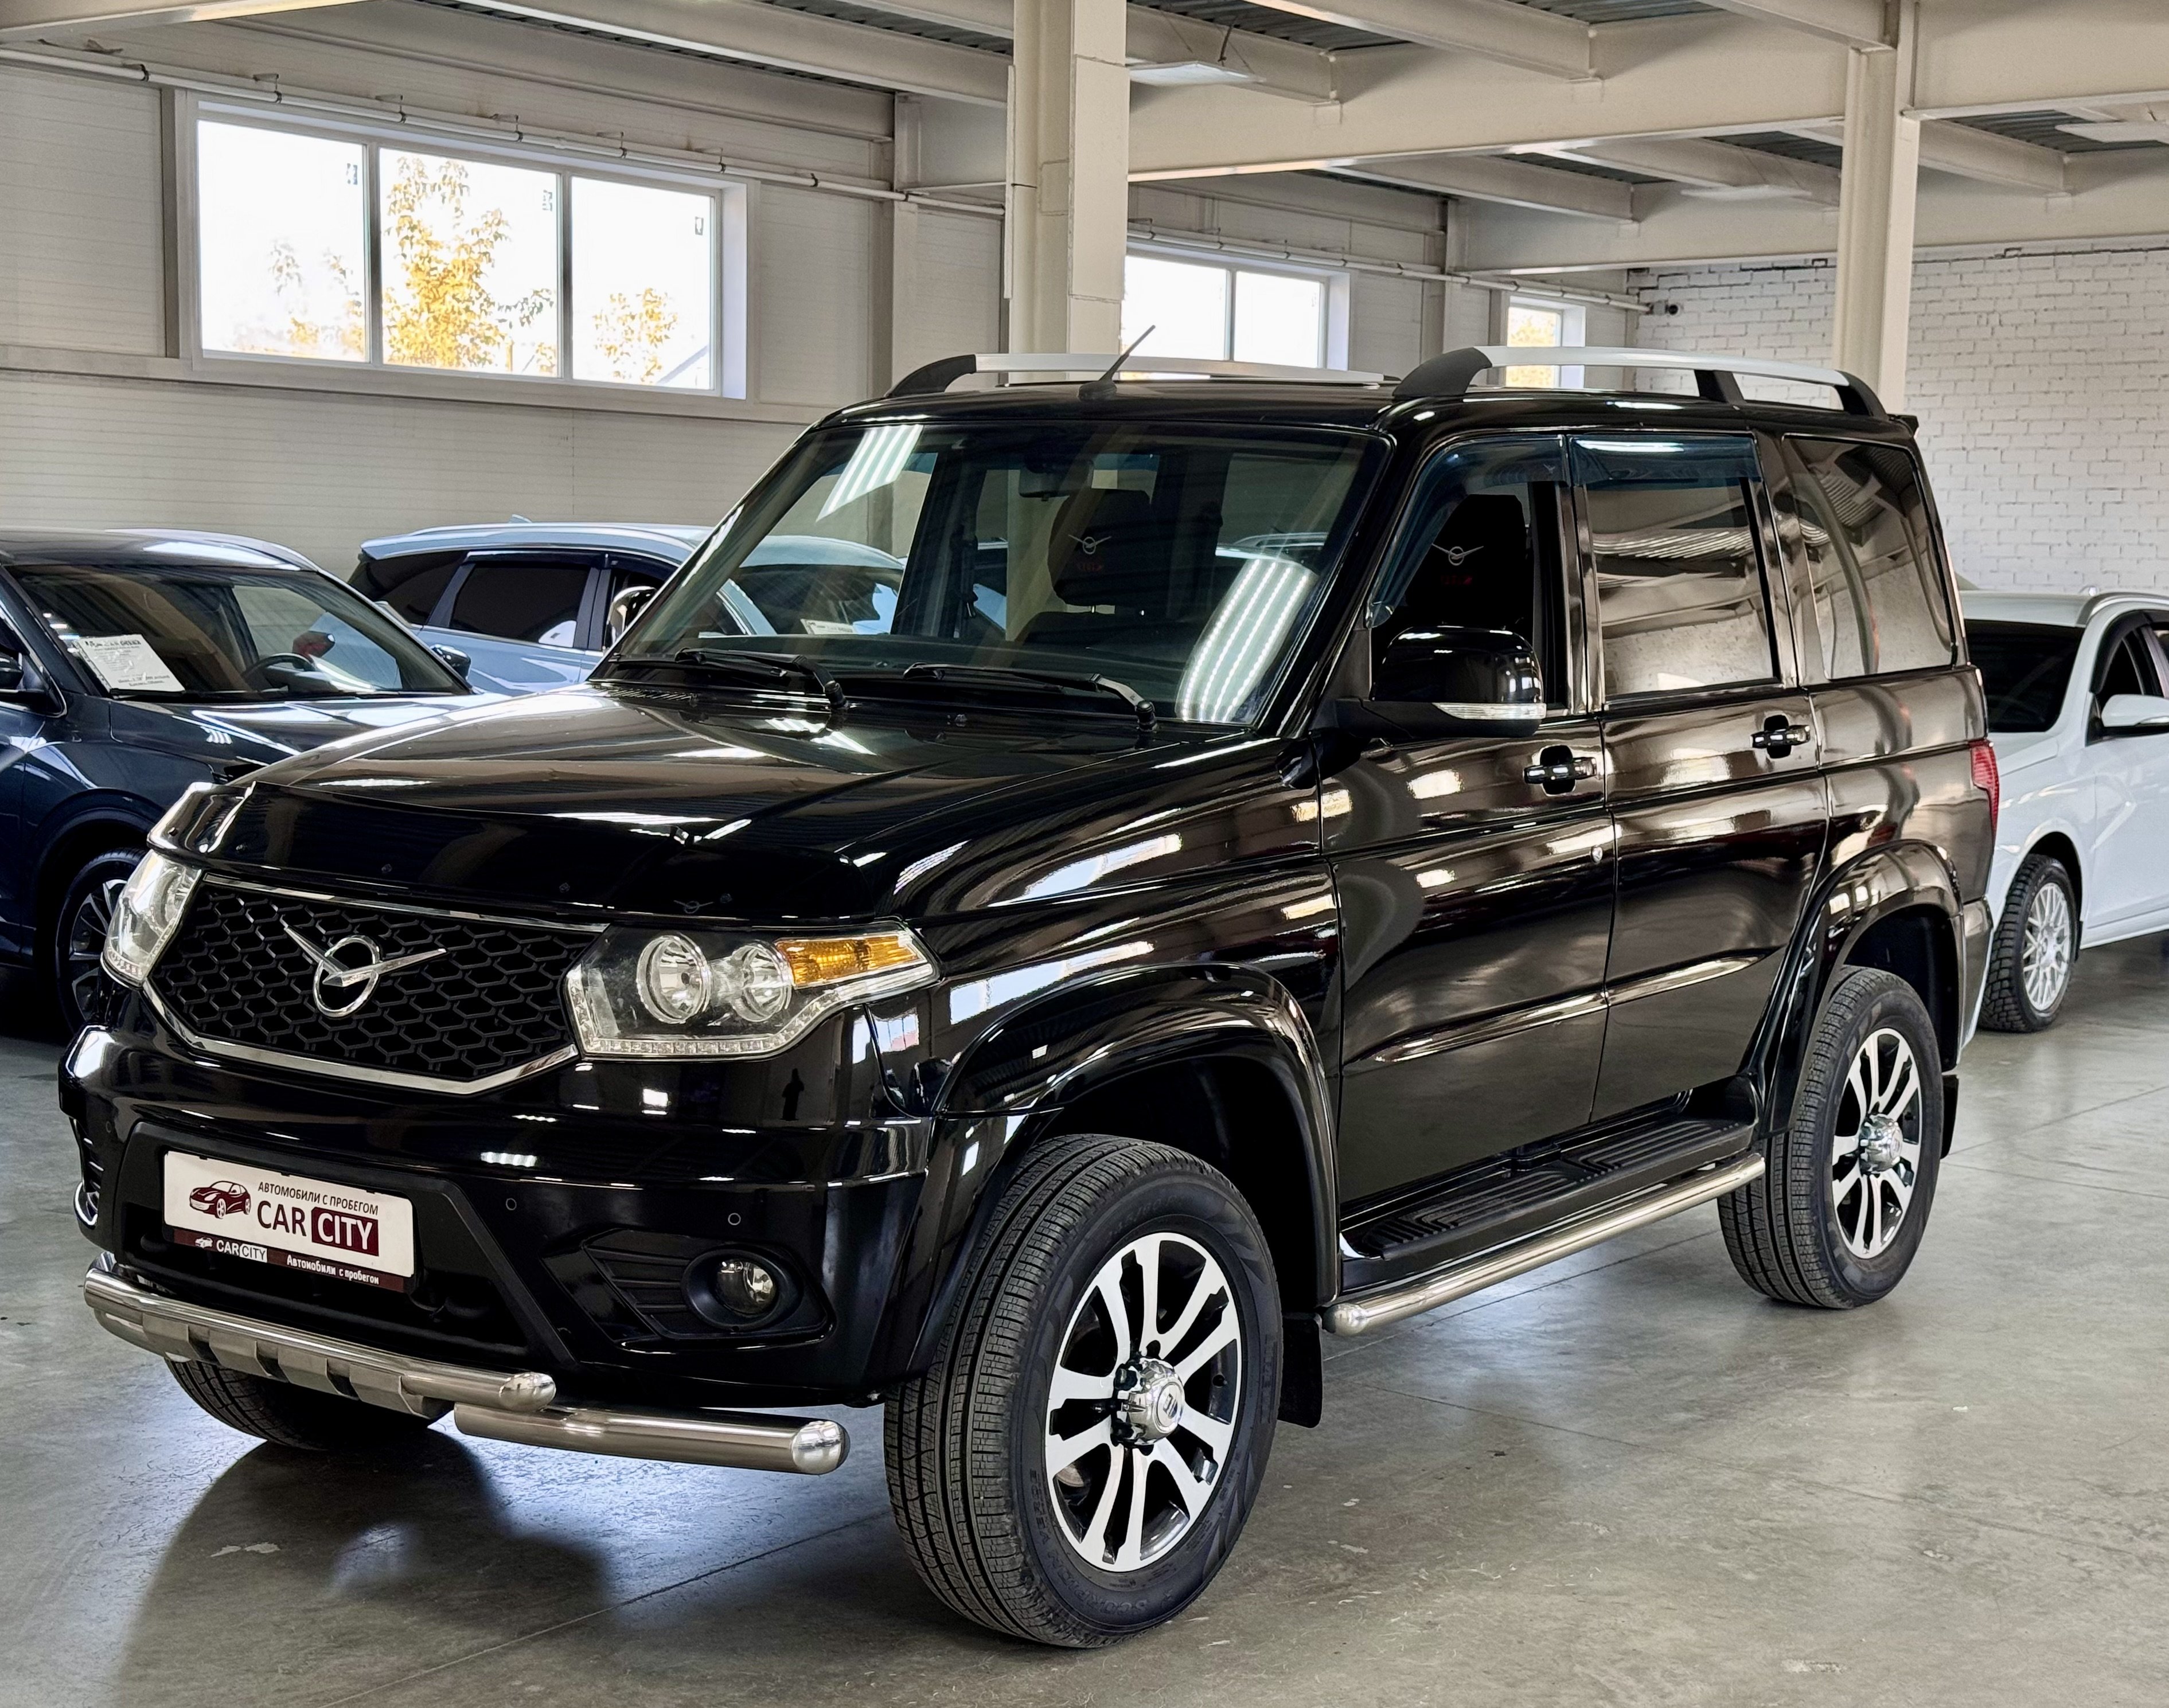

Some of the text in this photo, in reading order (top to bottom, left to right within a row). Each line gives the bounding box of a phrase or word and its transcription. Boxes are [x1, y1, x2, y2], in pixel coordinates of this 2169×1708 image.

[258, 1181, 379, 1216] АВТОМОБИЛИ С ПРОБЕГОМ
[257, 1200, 373, 1250] CAR CITY
[286, 1254, 379, 1285] Автомобили с пробегом
